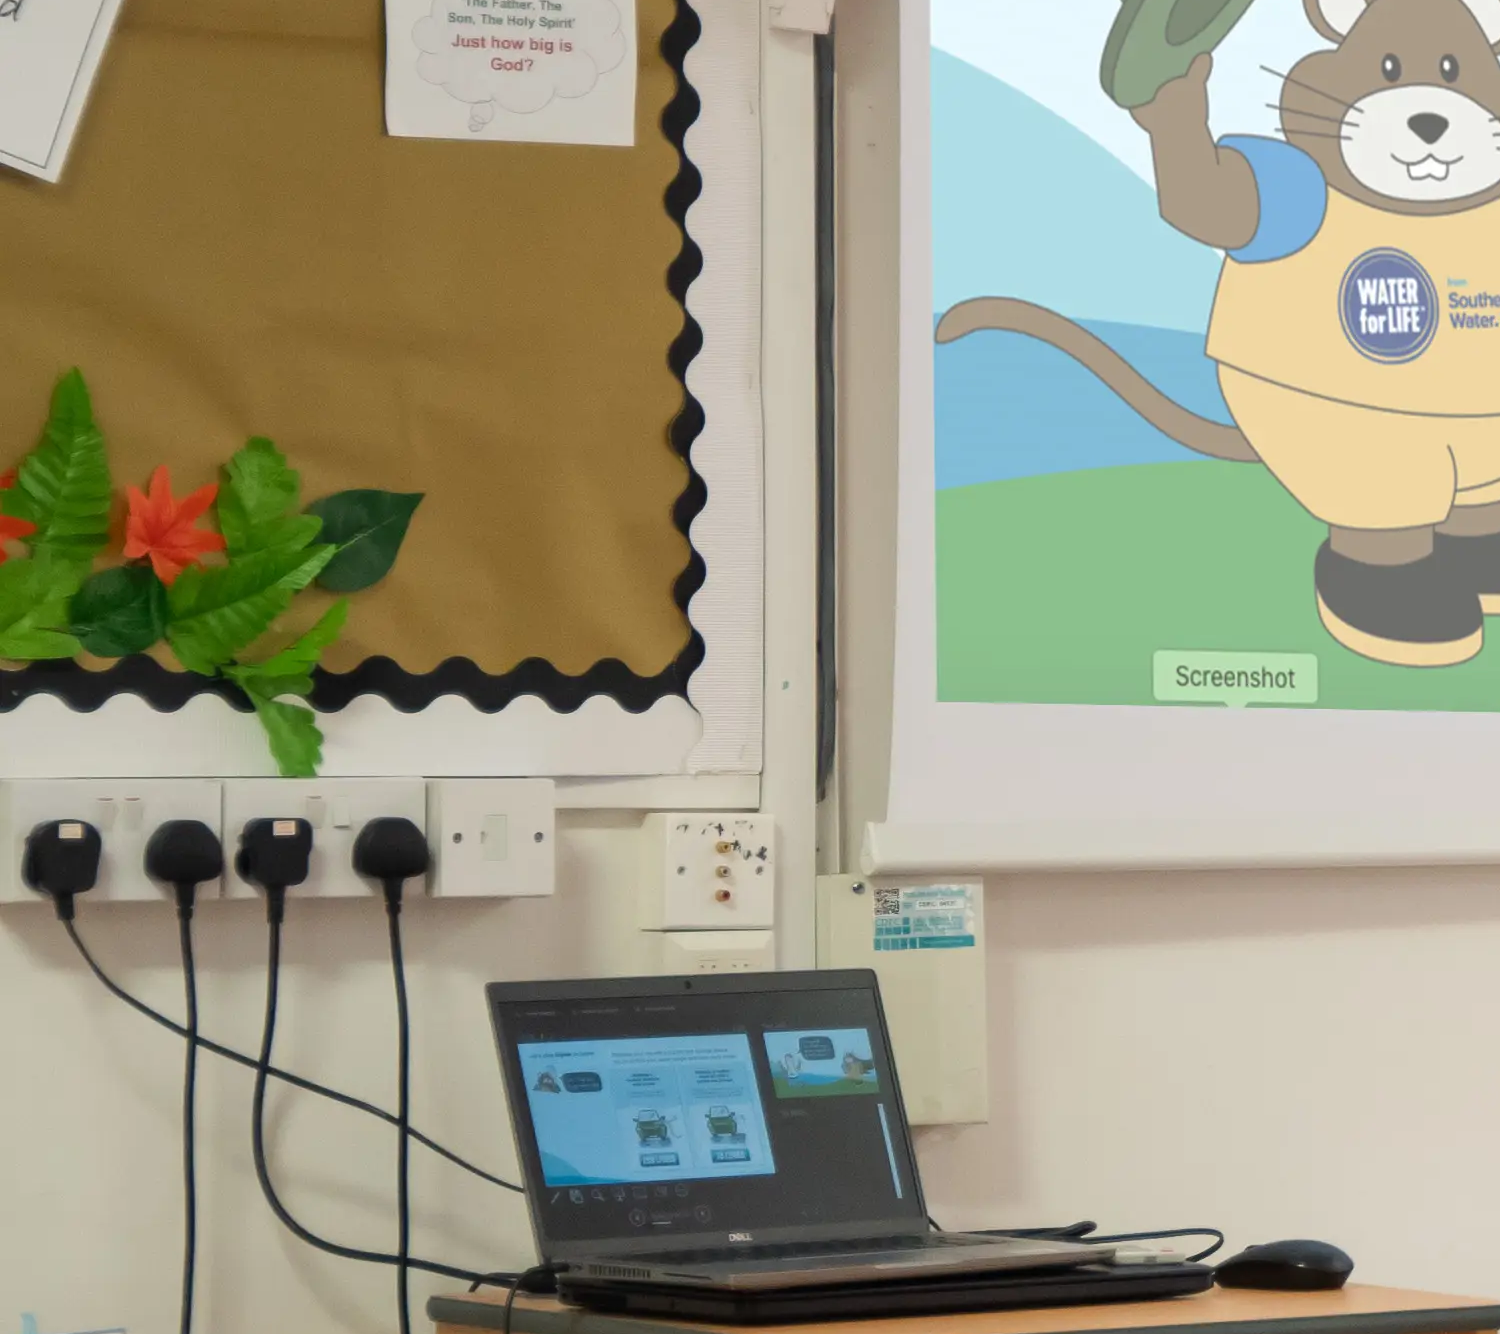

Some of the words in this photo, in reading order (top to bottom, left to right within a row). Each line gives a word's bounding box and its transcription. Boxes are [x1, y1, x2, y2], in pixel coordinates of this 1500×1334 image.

[541, 0, 562, 12] The
[448, 12, 476, 26] Son,
[481, 13, 503, 26] The
[507, 15, 535, 29] Holy
[451, 34, 487, 49] Just
[491, 36, 525, 51] how
[529, 37, 554, 54] big
[559, 39, 573, 52] is
[490, 57, 534, 72] God?
[1357, 277, 1419, 306] WATER
[1359, 308, 1387, 334] for
[1176, 665, 1296, 689] Screenshot
